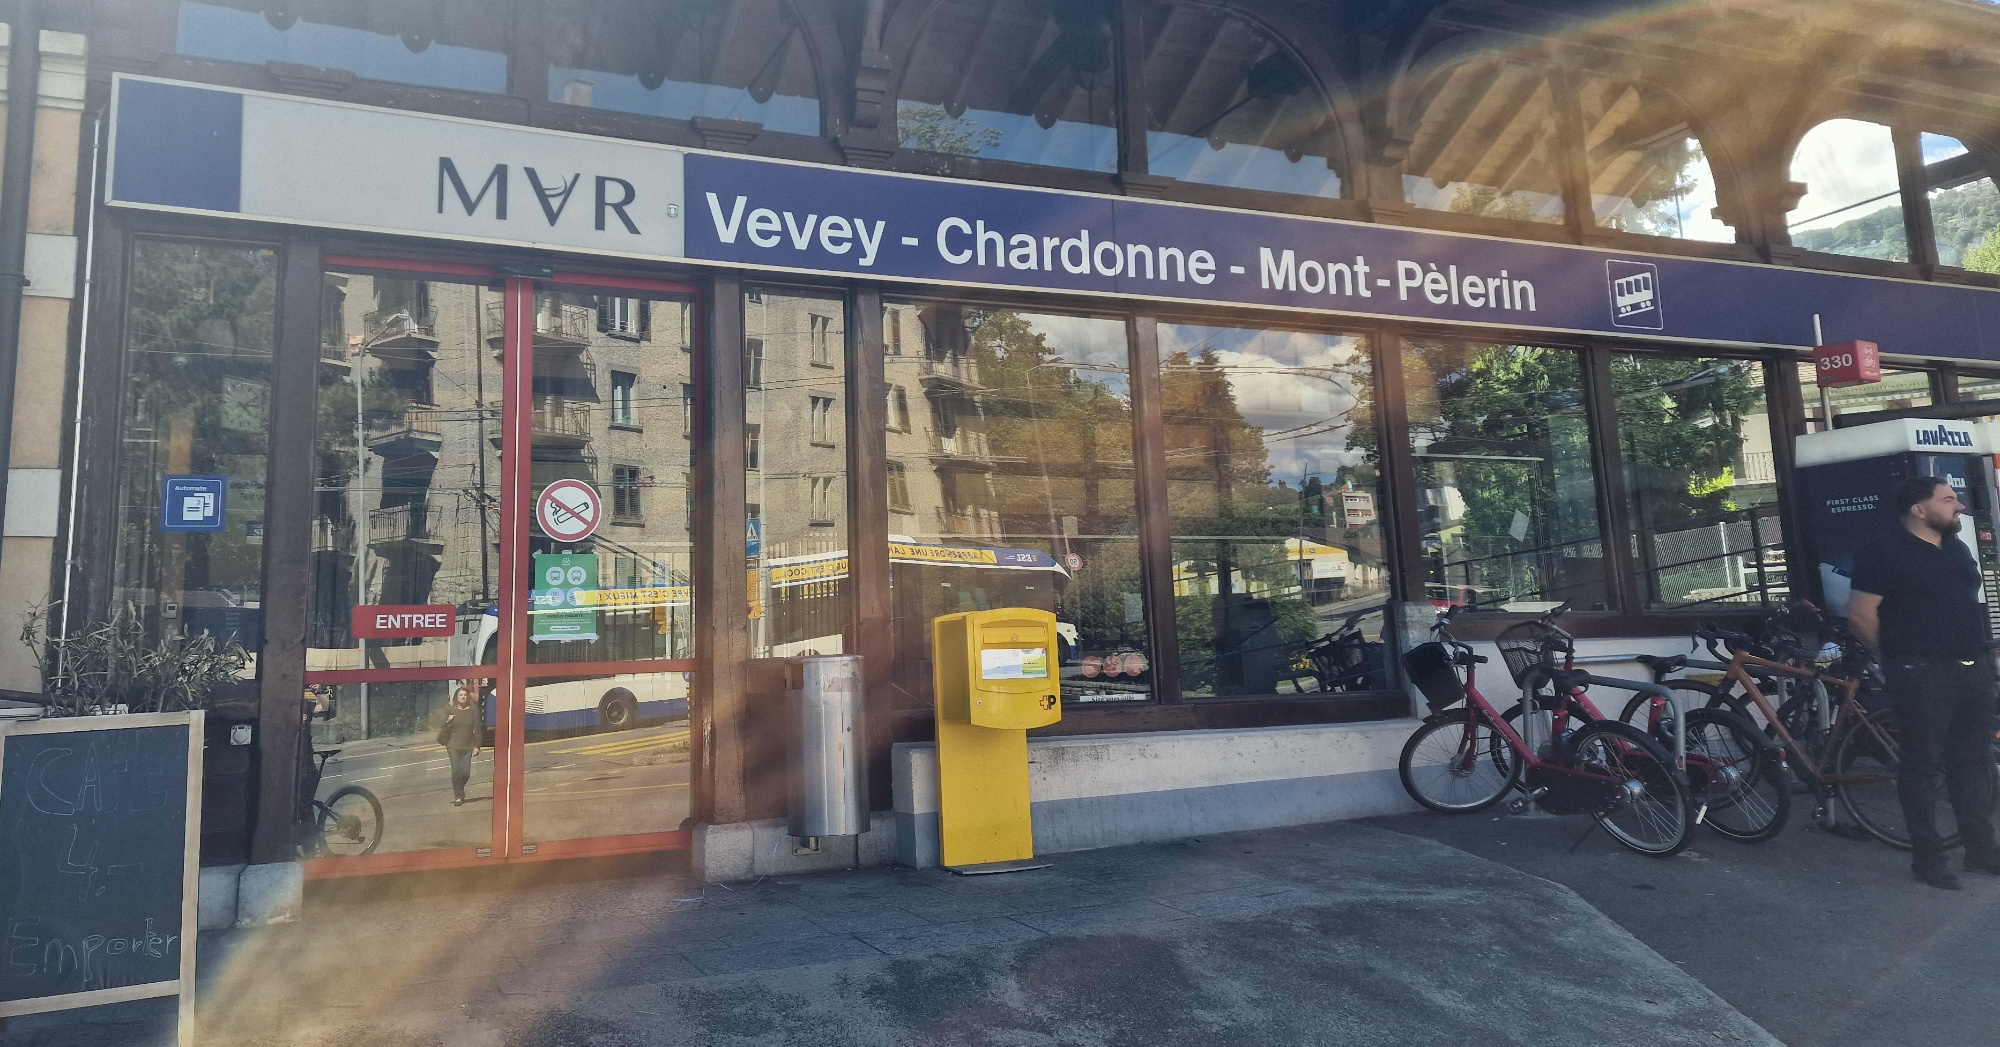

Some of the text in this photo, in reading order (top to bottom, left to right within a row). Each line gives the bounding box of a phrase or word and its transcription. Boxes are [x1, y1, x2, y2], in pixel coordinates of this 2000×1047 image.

[437, 155, 642, 236] MVR
[704, 191, 1537, 313] Vevey - Chardonne - Mont-Pèlerin
[1820, 353, 1853, 371] 330
[1915, 424, 1974, 447] LAVAZZA
[1944, 473, 1967, 489] AZZA
[1826, 494, 1879, 506] FIRST CLASS
[1831, 503, 1877, 514] ESPRESSO.
[375, 613, 448, 630] ENTREE
